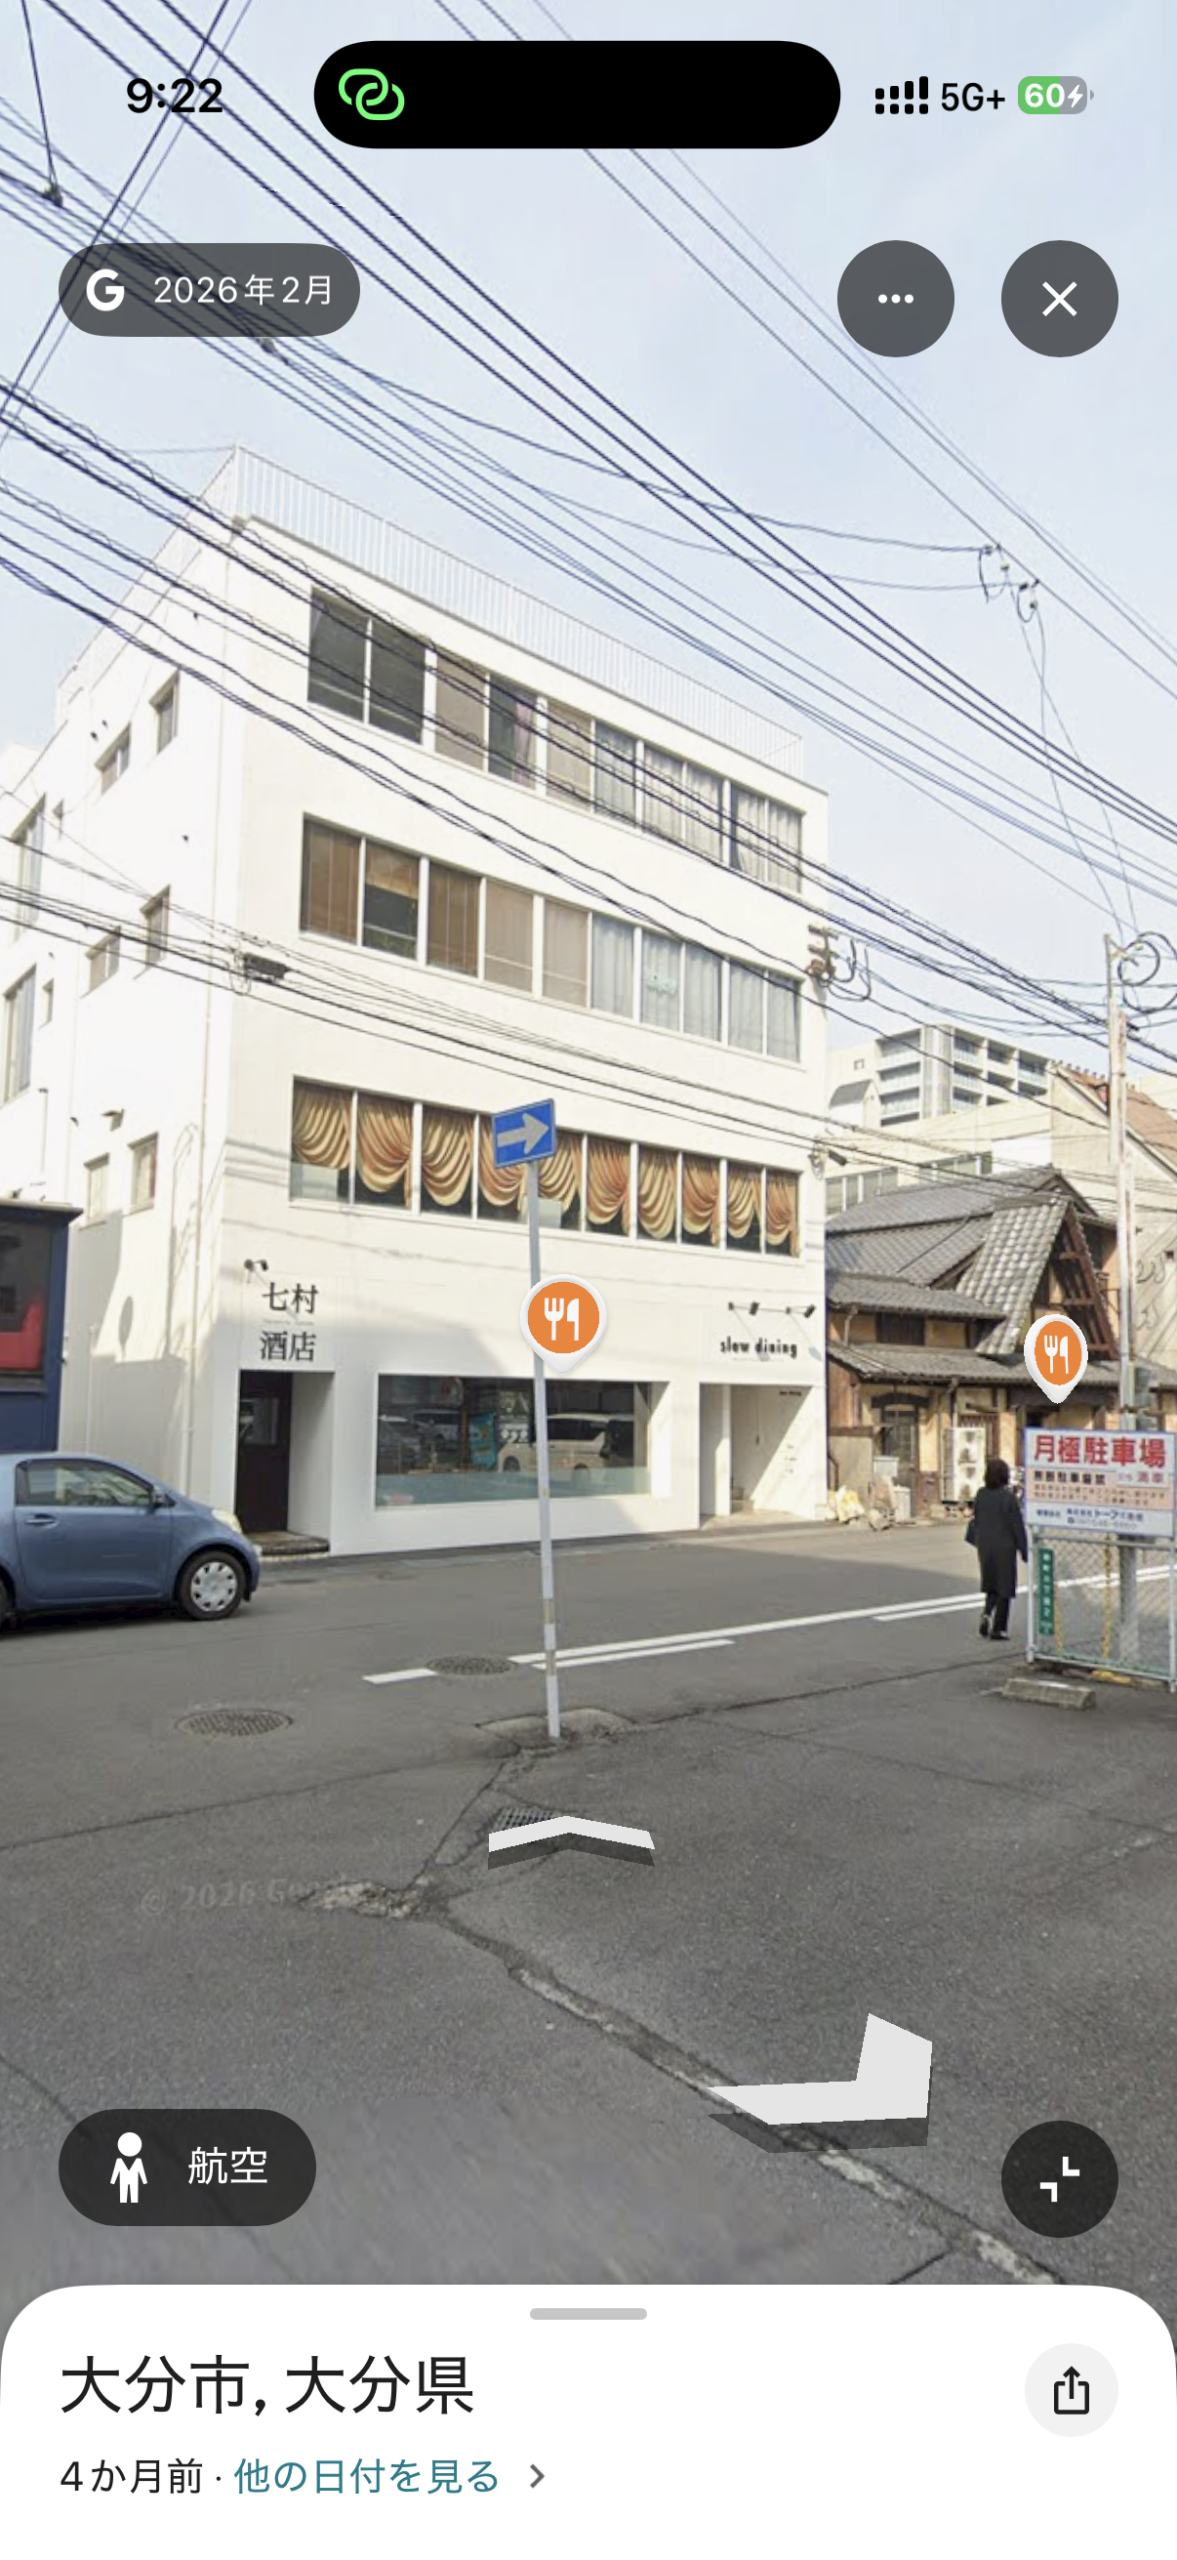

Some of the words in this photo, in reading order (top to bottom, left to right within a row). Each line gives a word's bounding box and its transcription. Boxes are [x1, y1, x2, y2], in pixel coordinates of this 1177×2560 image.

[261, 1282, 318, 1314] 七村
[260, 1331, 316, 1361] 酒店
[720, 1336, 749, 1354] slow
[755, 1337, 797, 1360] dining
[1034, 1434, 1167, 1468] 月極駐車場
